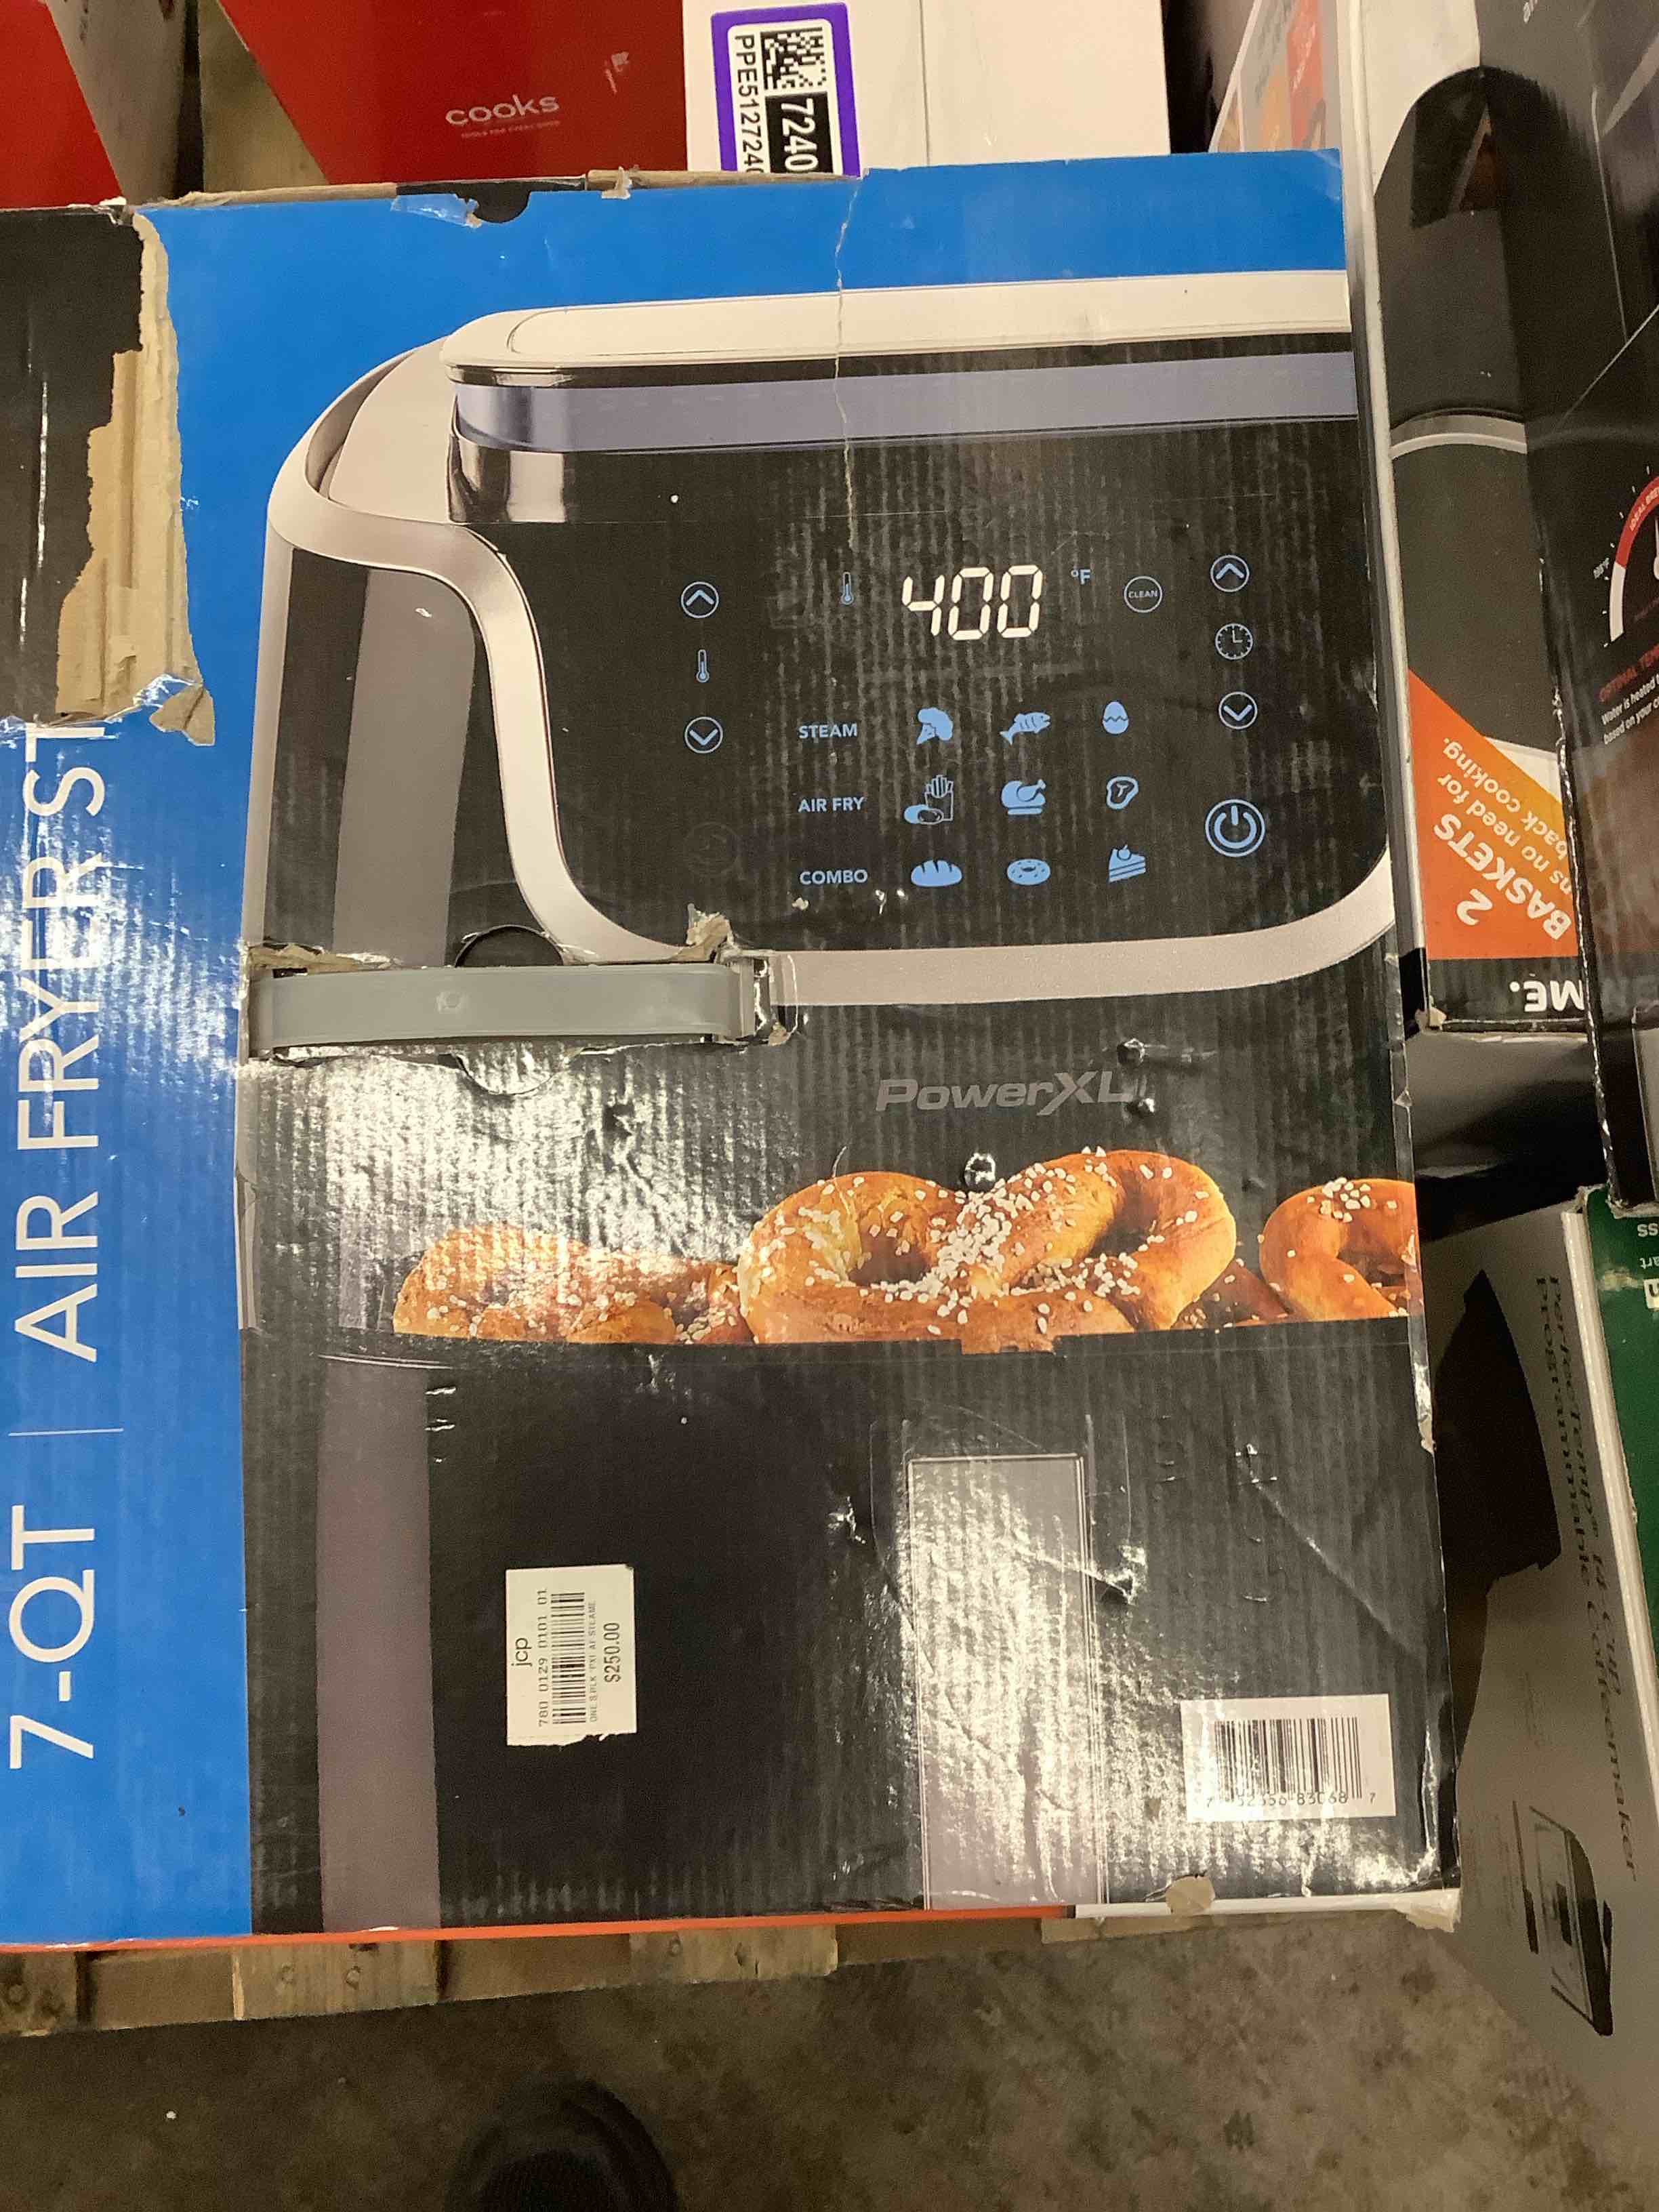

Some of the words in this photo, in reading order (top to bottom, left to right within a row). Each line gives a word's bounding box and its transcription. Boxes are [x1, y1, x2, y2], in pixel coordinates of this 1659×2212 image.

[445, 93, 560, 126] cooks
[781, 98, 819, 173] 7240
[901, 565, 1044, 640] 400
[1128, 590, 1158, 599] CLEAN
[798, 722, 858, 739] STEAM
[1437, 773, 1470, 804] for
[1442, 737, 1521, 813] cooking.
[798, 798, 827, 813] AIR
[832, 796, 865, 812] FRY
[1465, 798, 1521, 848] need
[1520, 809, 1569, 861] back
[799, 868, 868, 885] COMBO
[1433, 813, 1572, 941] BASKETS
[1521, 845, 1551, 873] no
[1456, 888, 1493, 926] 2
[17, 852, 102, 1151] FRYER
[1509, 979, 1585, 1012] ME.
[876, 1071, 1134, 1117] PowerXL
[14, 1190, 99, 1363] AIR
[9, 1504, 96, 1770] 7-QT
[511, 1637, 533, 1668] jcp
[603, 1622, 621, 1683] $250.00
[1369, 1792, 1376, 1804] 7
